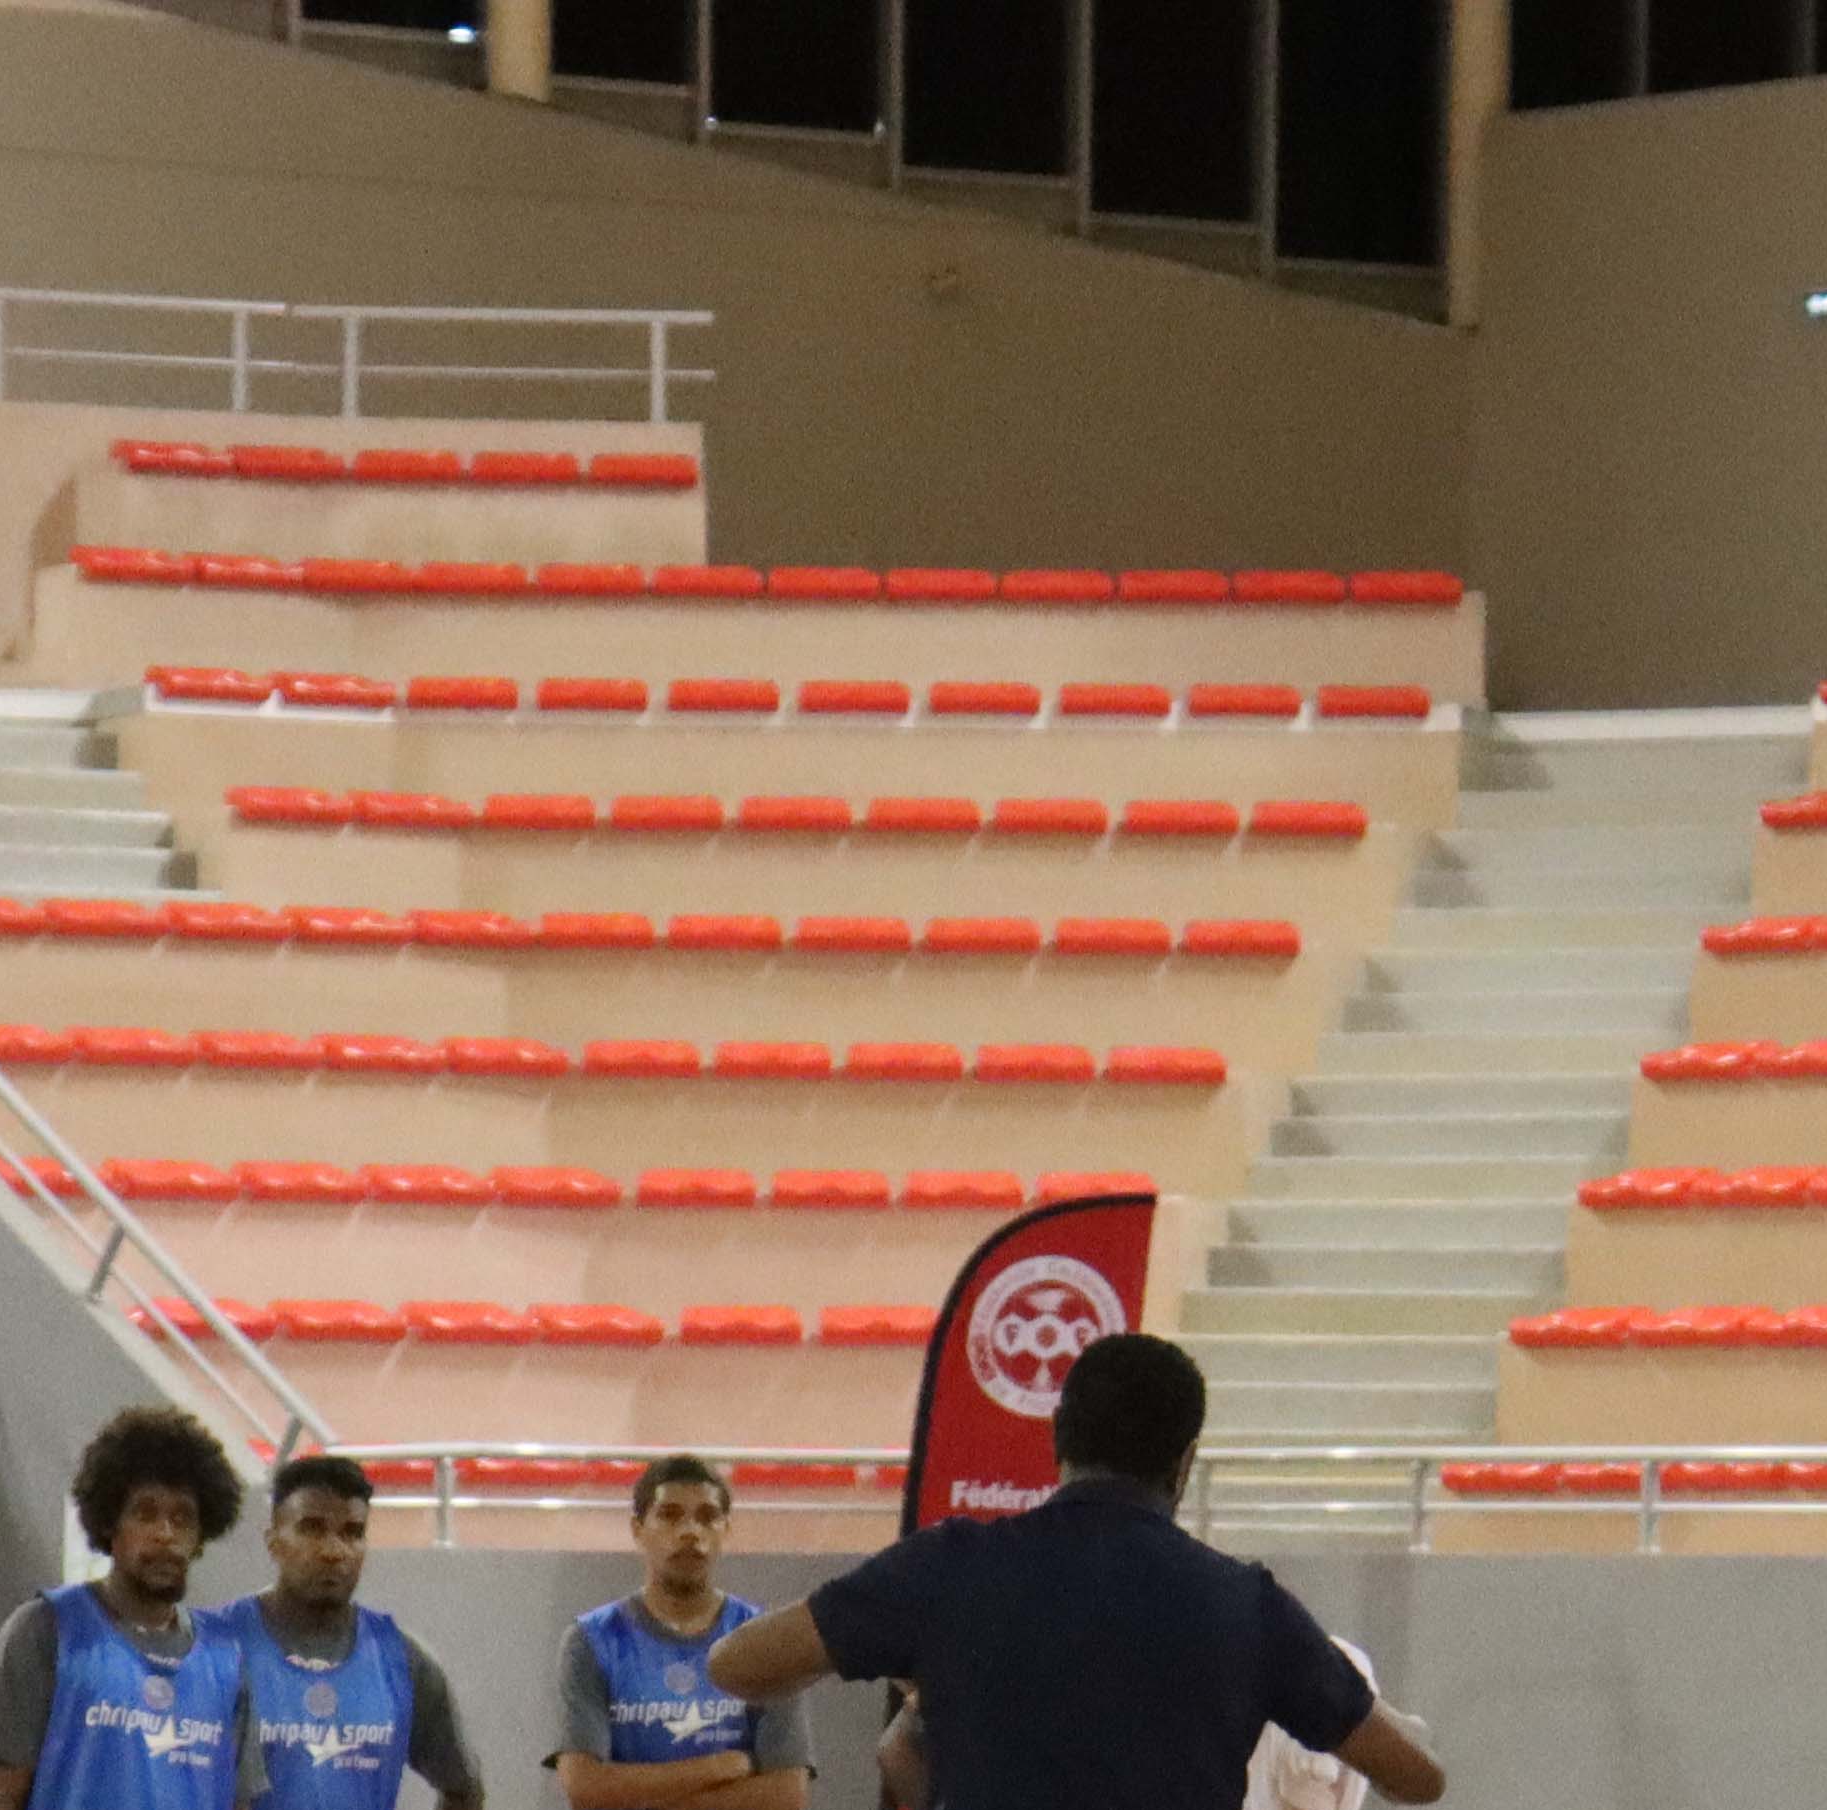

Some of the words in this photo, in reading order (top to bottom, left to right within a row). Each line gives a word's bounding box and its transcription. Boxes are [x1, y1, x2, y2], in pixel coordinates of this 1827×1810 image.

[179, 1716, 223, 1747] sport
[258, 1717, 323, 1749] hripau
[342, 1720, 395, 1749] sport
